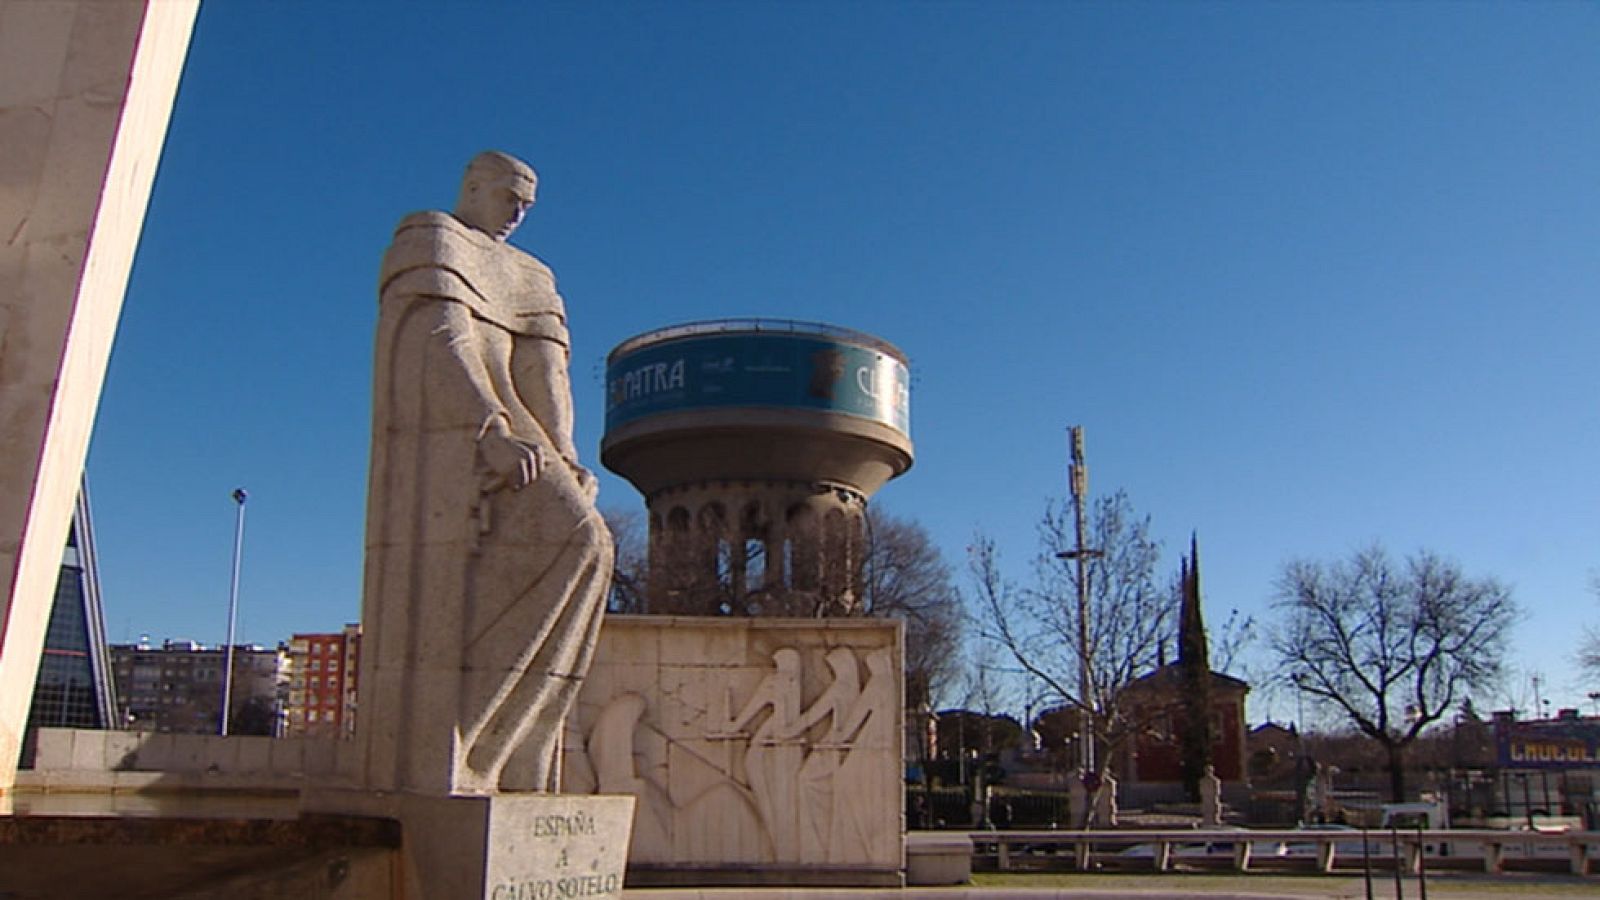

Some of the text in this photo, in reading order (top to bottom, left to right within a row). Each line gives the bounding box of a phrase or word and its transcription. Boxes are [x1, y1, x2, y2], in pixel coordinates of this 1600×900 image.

[533, 809, 596, 837] ESPAÑA
[555, 847, 569, 868] A
[556, 873, 617, 900] SOTELO
